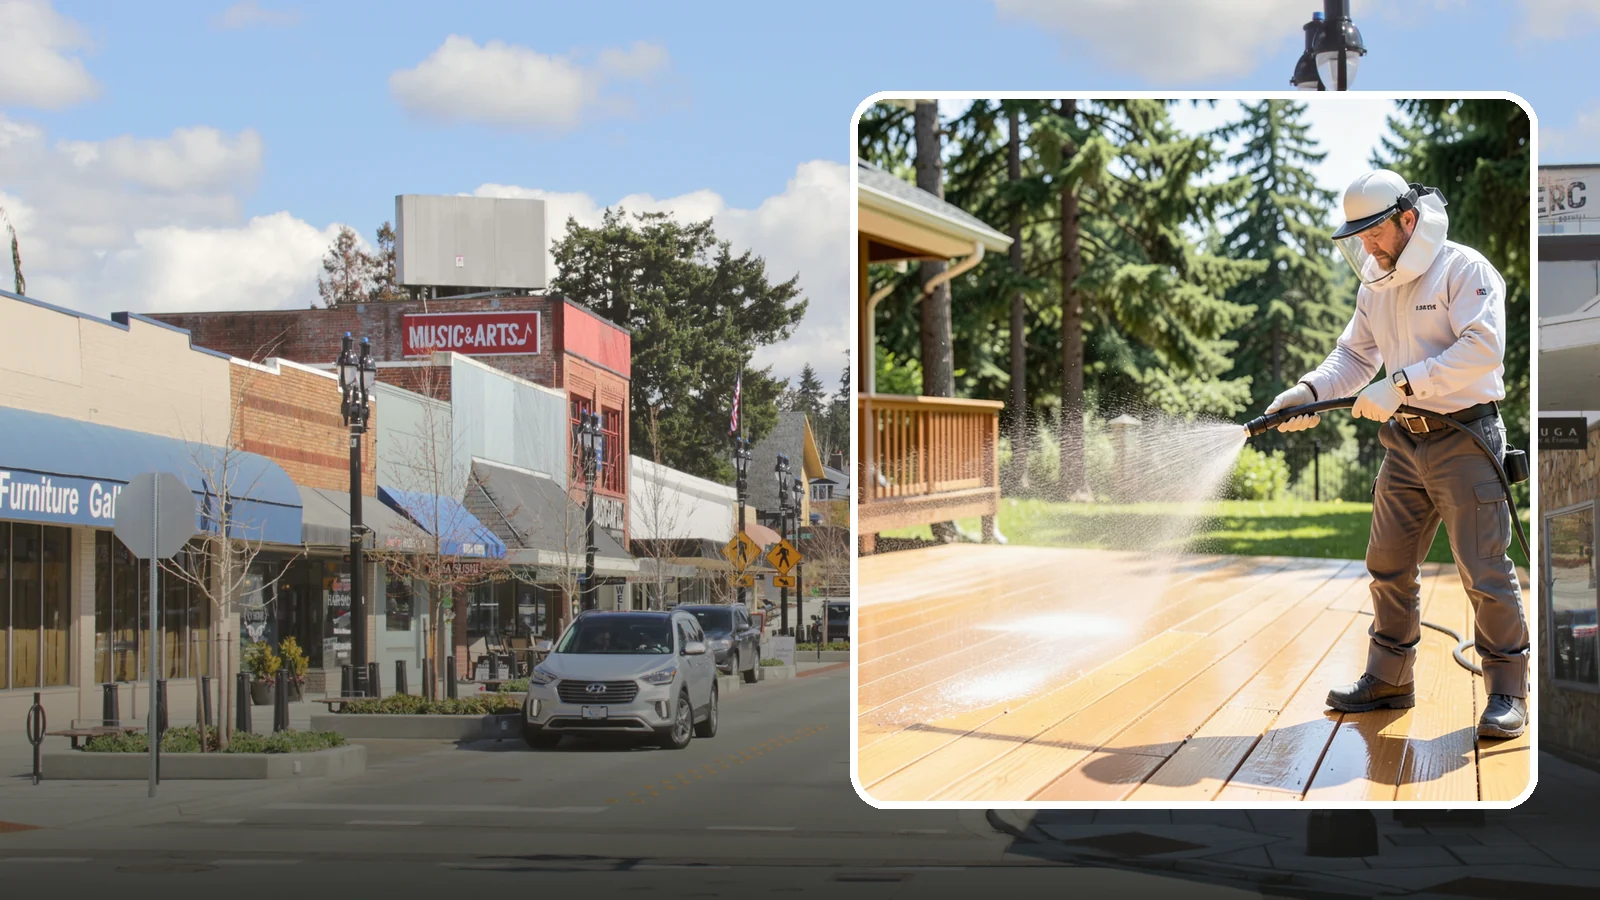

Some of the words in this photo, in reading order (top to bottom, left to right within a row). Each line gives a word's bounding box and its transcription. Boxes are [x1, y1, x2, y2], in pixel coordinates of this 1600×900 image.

[408, 323, 519, 349] MUSIC&ARTS
[1540, 427, 1577, 436] UGA
[0, 472, 79, 515] Furniture
[453, 563, 480, 575] SUSHI
